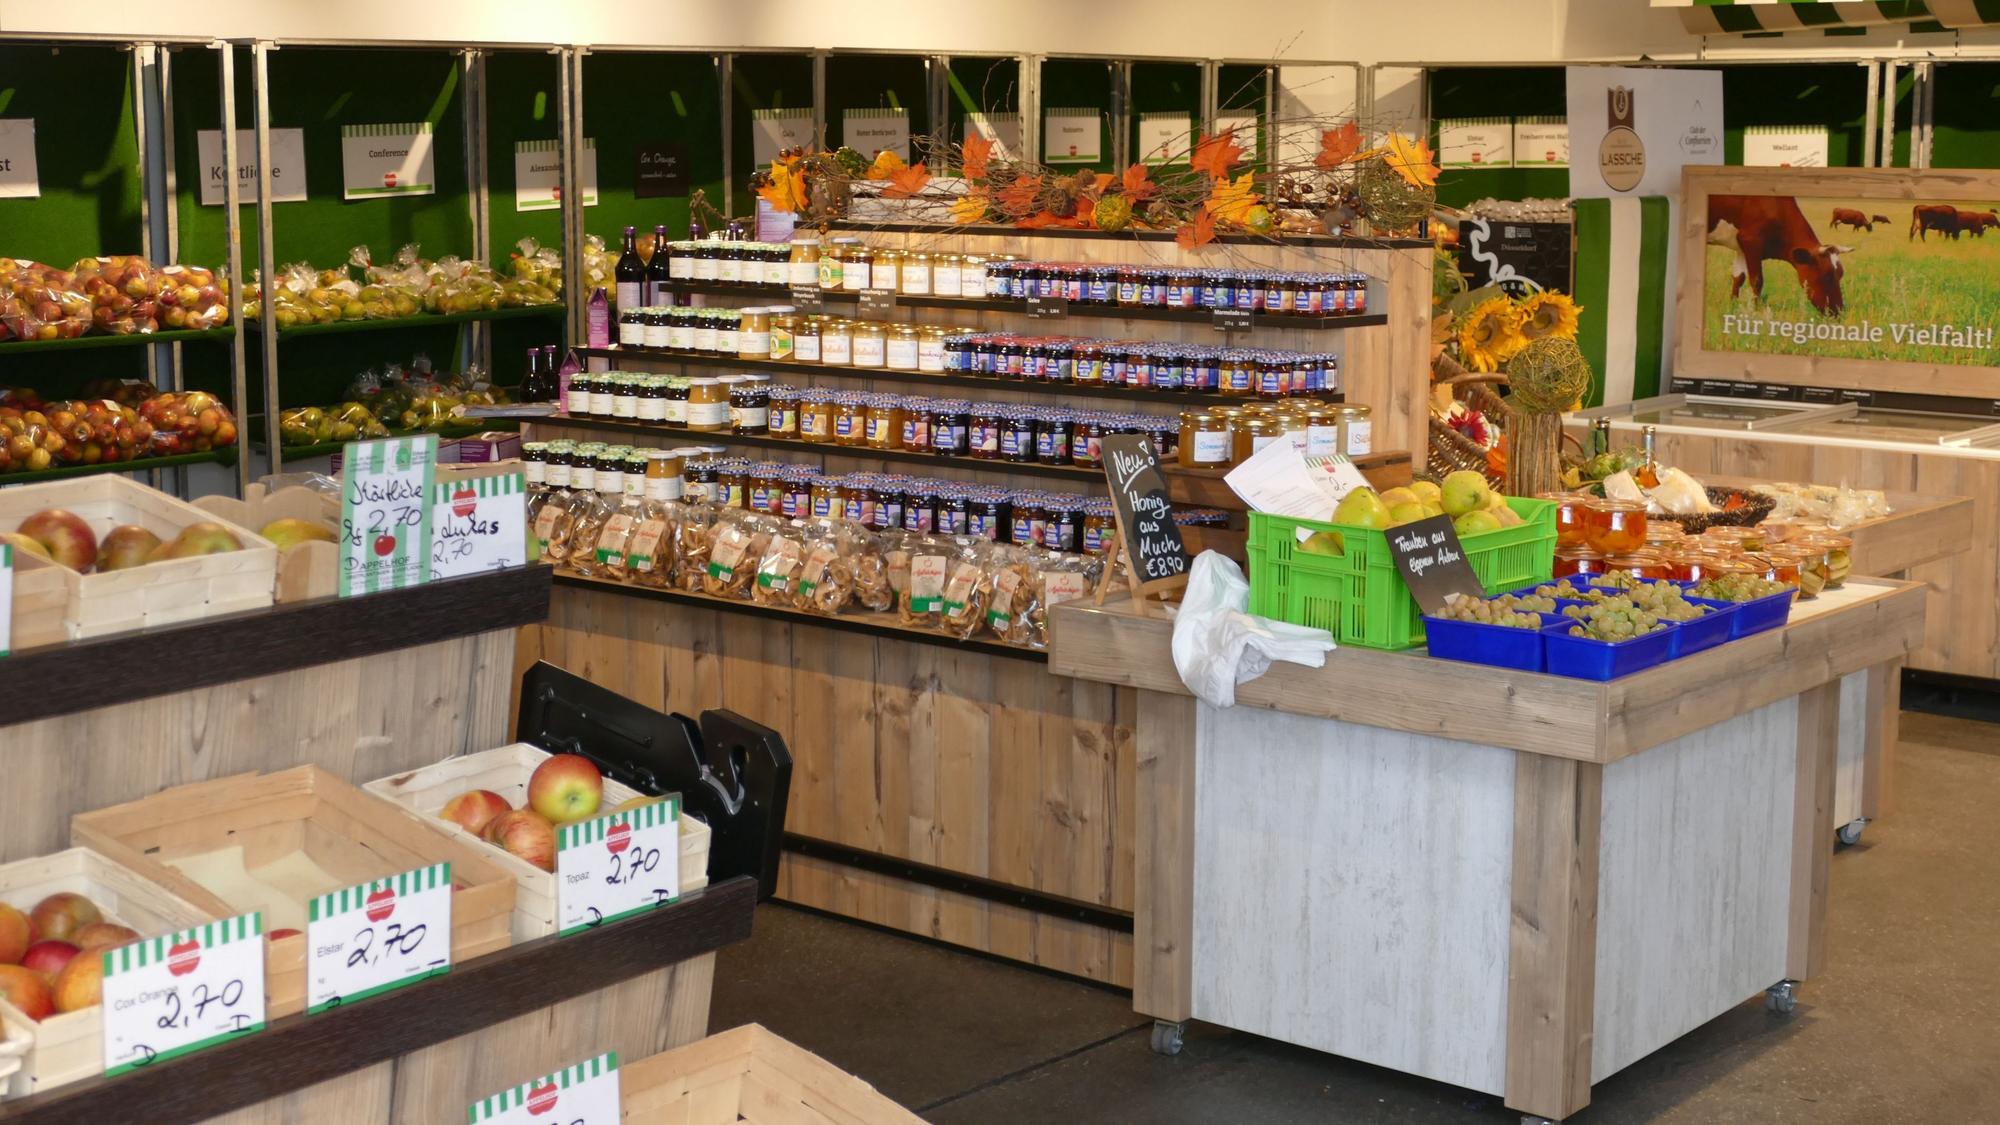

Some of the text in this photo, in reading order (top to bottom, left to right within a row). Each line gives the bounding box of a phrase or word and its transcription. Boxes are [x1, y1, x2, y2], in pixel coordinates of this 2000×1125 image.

[368, 149, 409, 158] Conference
[1723, 314, 1993, 350] Für regionale Vielfalt!
[1112, 439, 1155, 485] Neu!
[1129, 490, 1171, 520] Honig
[369, 505, 423, 536] 2,70
[1139, 520, 1160, 533] aus
[433, 538, 473, 564] 2,70
[1140, 534, 1181, 559] Much
[1394, 530, 1446, 553] Trauben aus
[360, 555, 411, 571] APPELHOF
[566, 871, 590, 885] Topaz
[605, 846, 660, 885] 2,70
[317, 942, 345, 958] Elstar
[347, 923, 427, 968] 2,70
[114, 1000, 136, 1011] Cox
[157, 979, 244, 1029] 2,70
